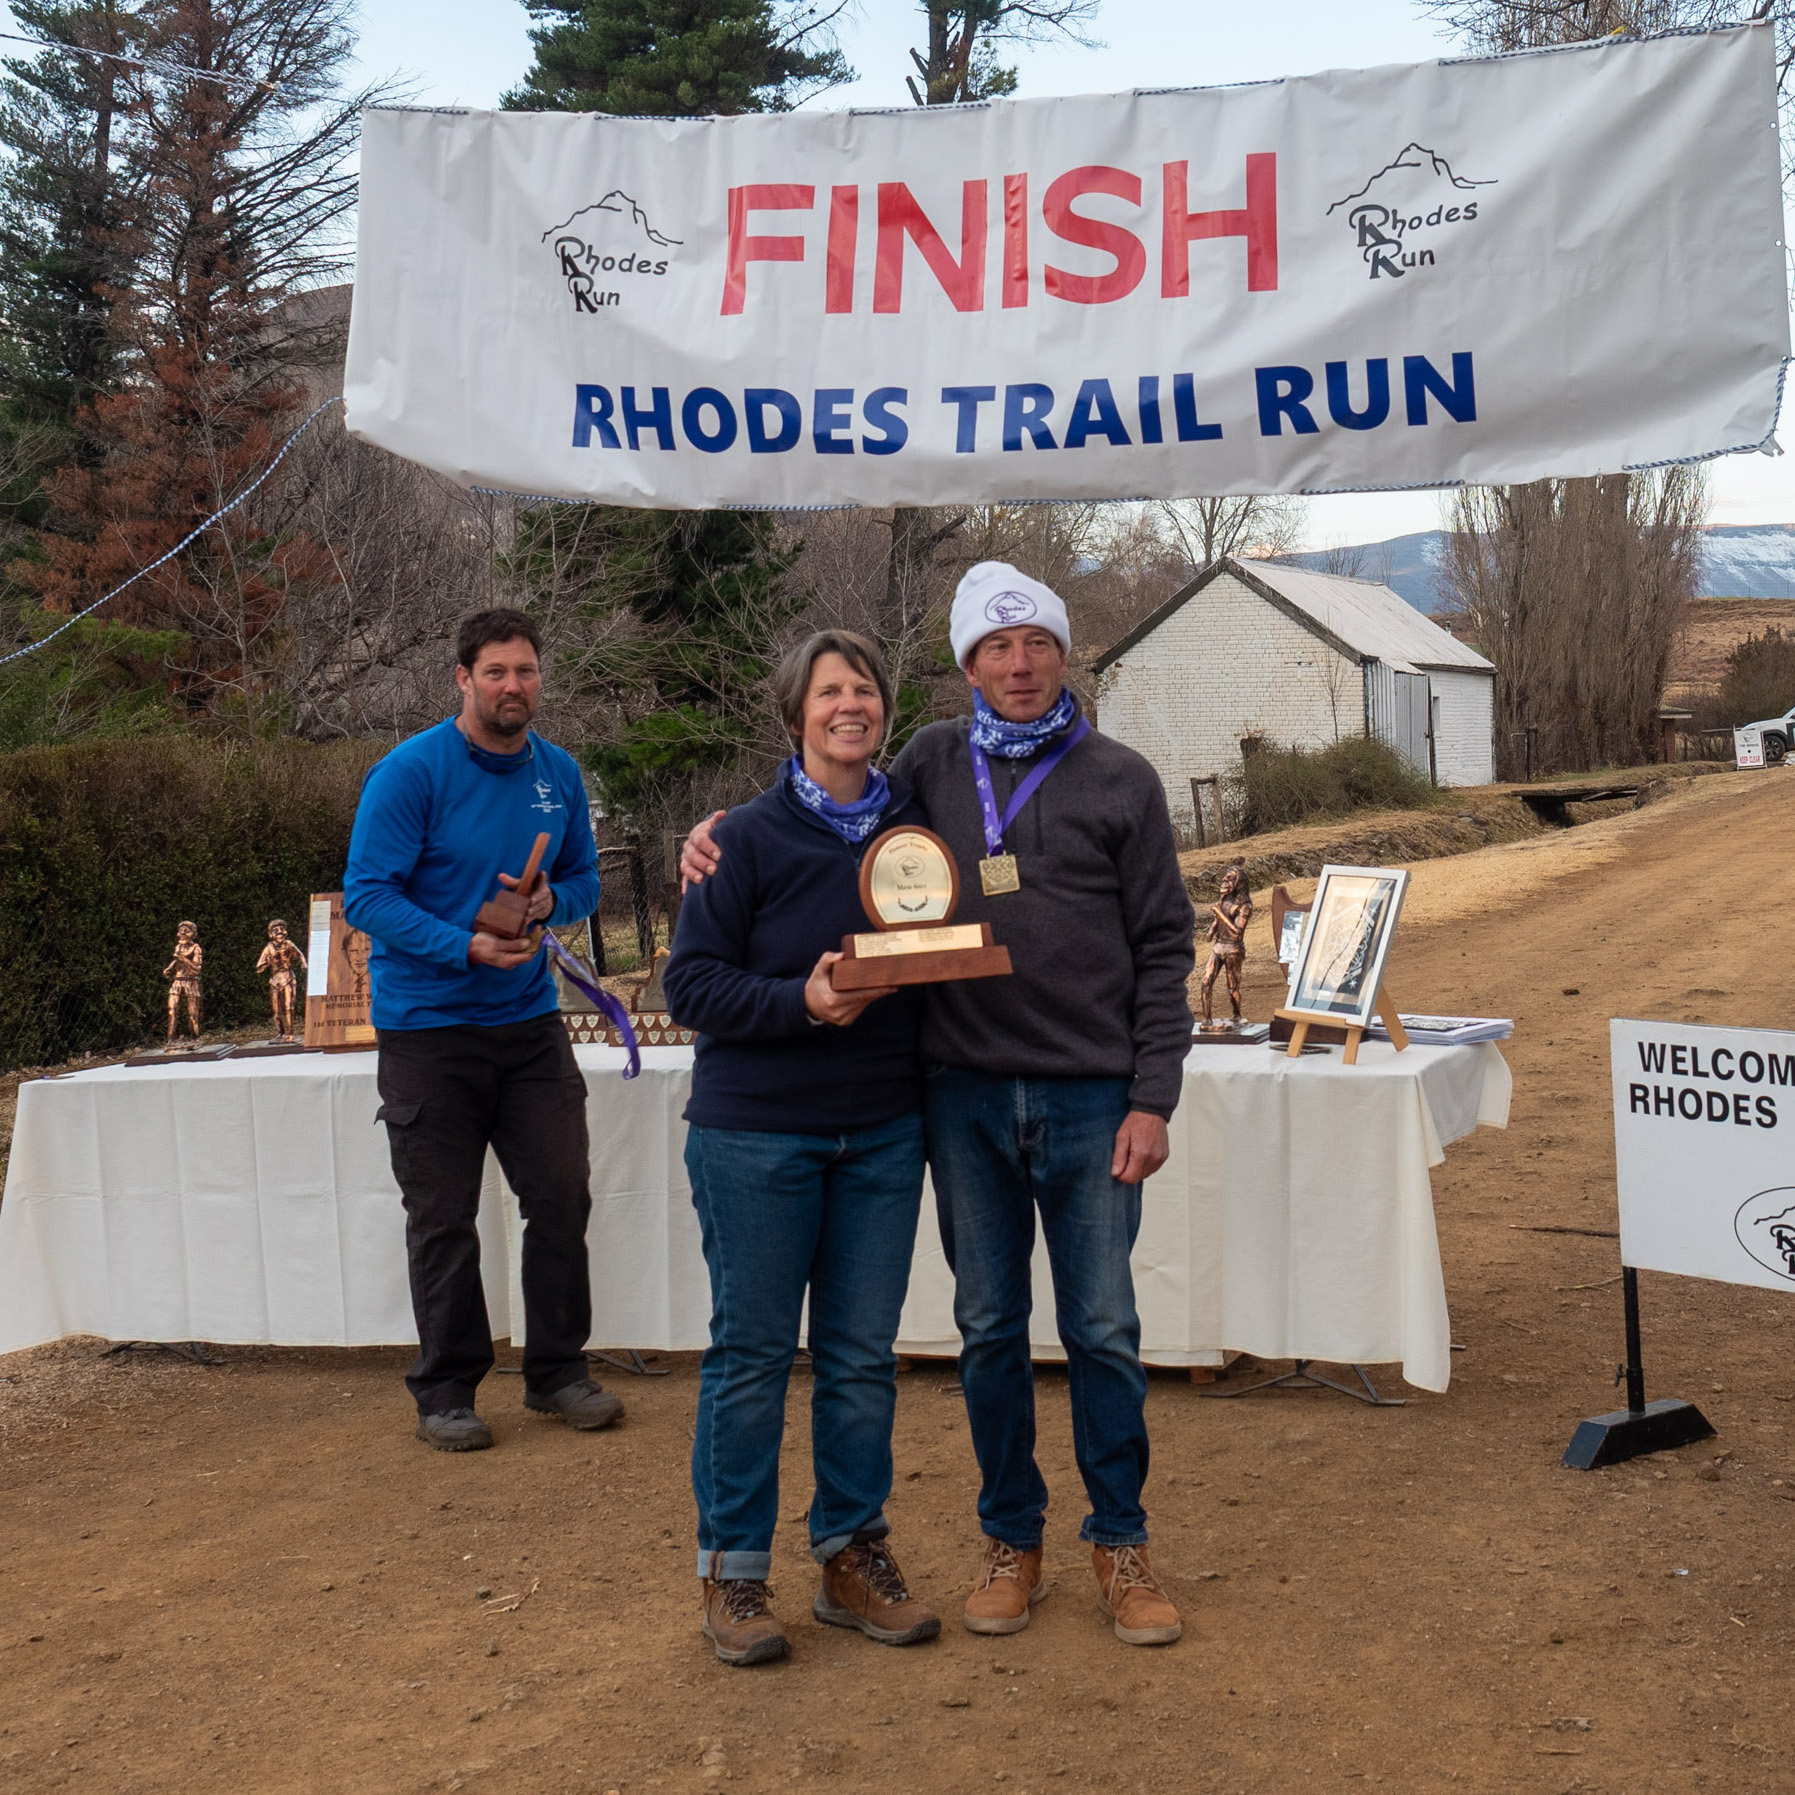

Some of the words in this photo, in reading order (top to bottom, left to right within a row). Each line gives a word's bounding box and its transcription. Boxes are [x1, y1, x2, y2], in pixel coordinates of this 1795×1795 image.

[720, 152, 1278, 316] FINISH
[1349, 201, 1478, 247] Rhodes
[555, 236, 669, 276] Rhodes
[1363, 239, 1435, 280] Run
[568, 272, 620, 314] Run
[572, 383, 909, 455] RHODES
[941, 373, 1223, 453] TRAIL
[1254, 351, 1477, 436] RUN
[321, 994, 364, 1002] MATTHEW
[326, 1018, 366, 1026] VETERAN
[1638, 1041, 1795, 1087] WELCOM
[1629, 1083, 1778, 1129] RHODES
